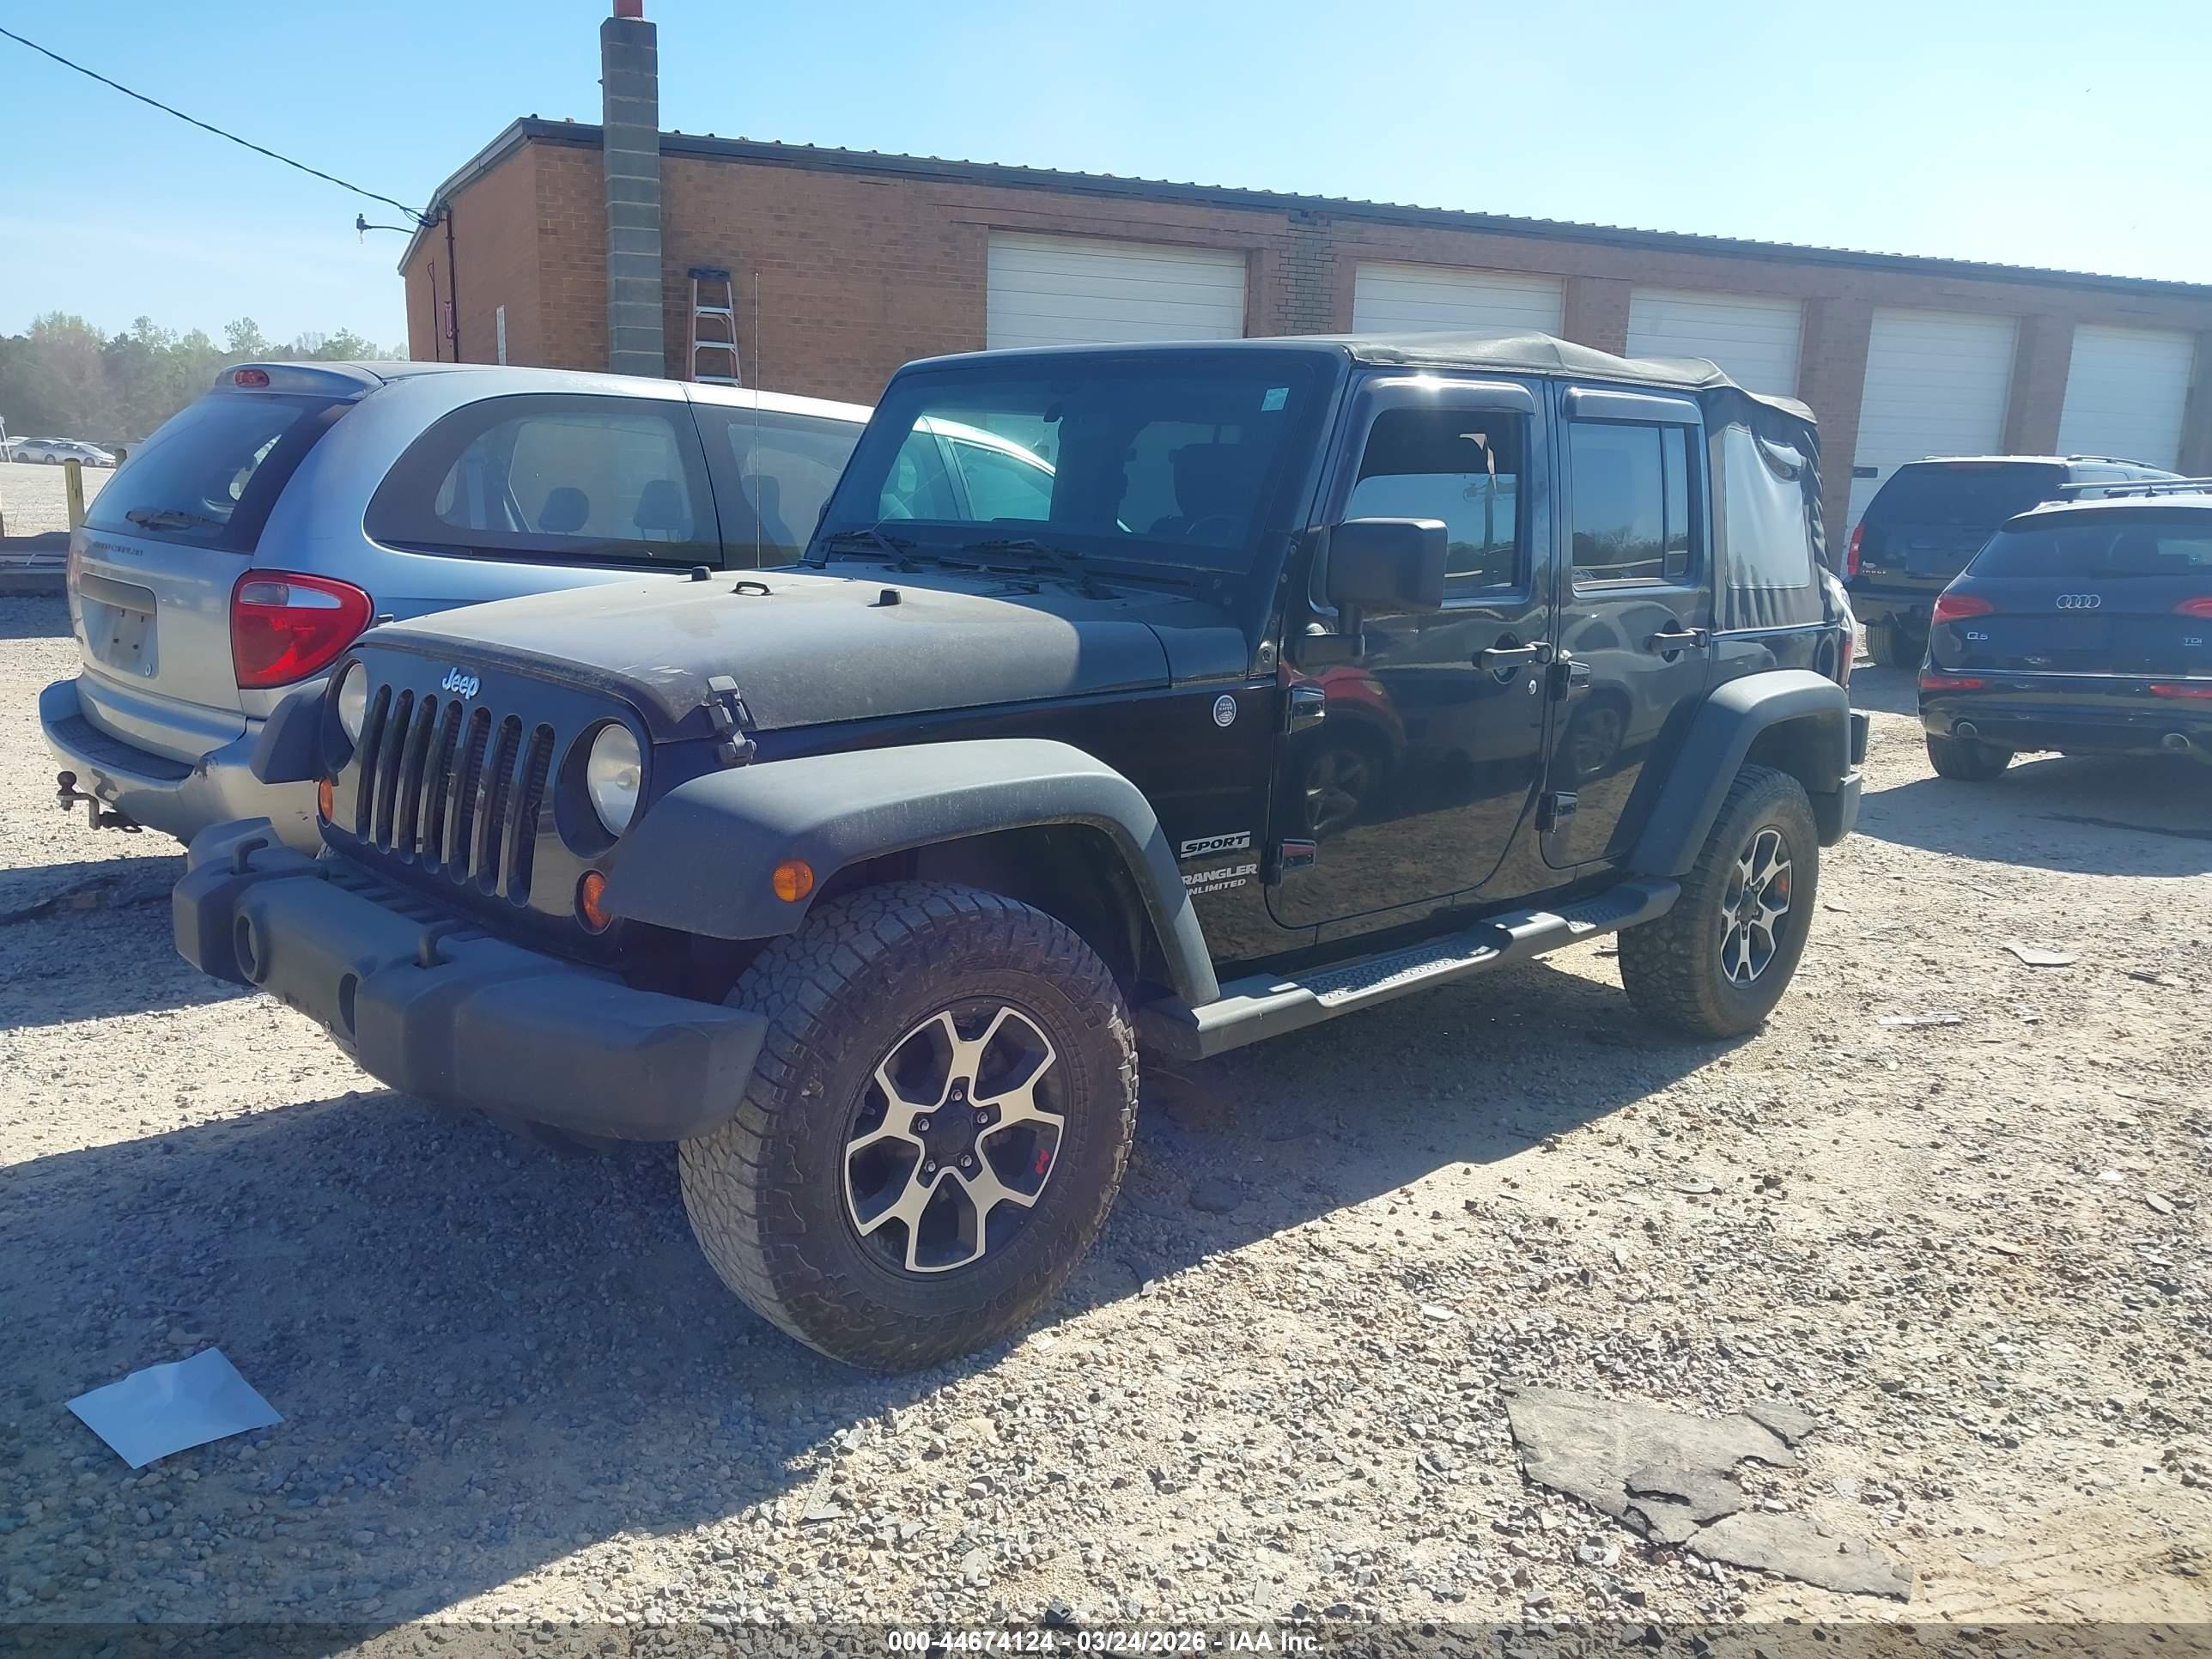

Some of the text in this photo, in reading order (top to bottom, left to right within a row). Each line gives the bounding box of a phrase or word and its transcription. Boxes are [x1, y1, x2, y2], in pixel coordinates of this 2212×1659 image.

[1967, 631, 1989, 641] Q5
[442, 666, 480, 700] Jeep
[1182, 836, 1250, 854] SPORT
[1182, 863, 1258, 885] RANGLER
[1186, 878, 1247, 896] NLIMITED
